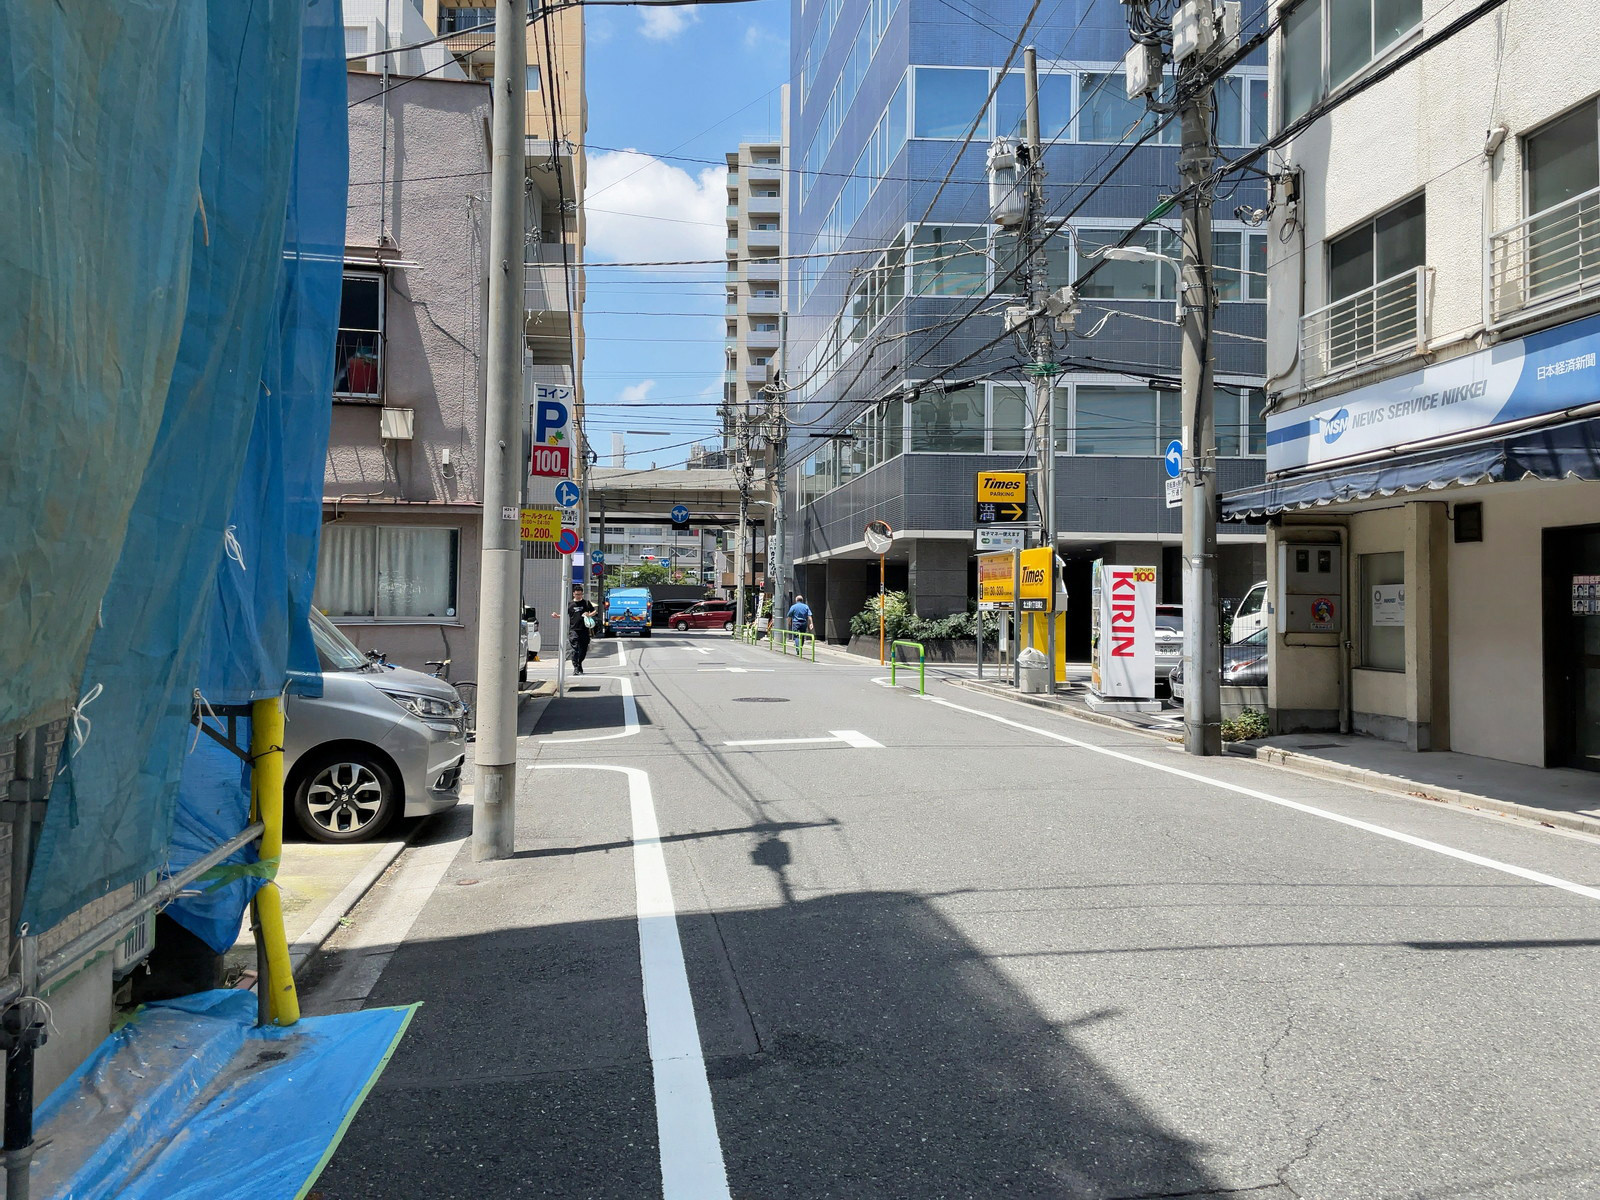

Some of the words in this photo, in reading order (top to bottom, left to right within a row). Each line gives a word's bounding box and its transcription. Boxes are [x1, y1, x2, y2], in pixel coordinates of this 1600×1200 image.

[1537, 352, 1596, 380] 日本経済新聞
[537, 388, 569, 399] コイン
[1352, 408, 1386, 430] NEWS
[1387, 392, 1439, 421] SERVICE
[1440, 379, 1488, 407] NIKKEI
[536, 401, 568, 443] P
[983, 478, 1021, 490] Times
[1021, 566, 1045, 584] Times
[1134, 572, 1155, 582] 100
[1111, 571, 1136, 658] KIRIN
